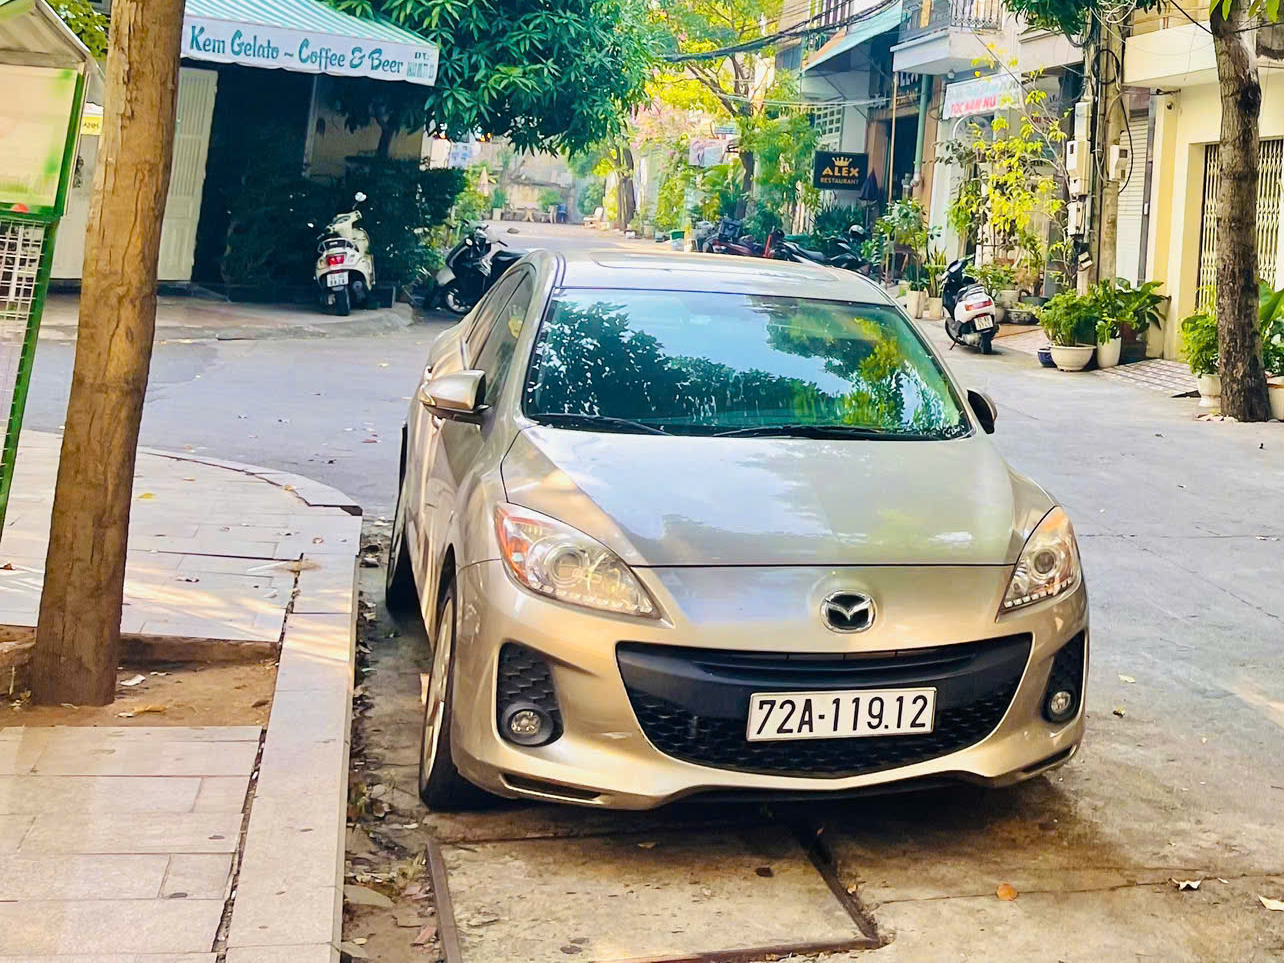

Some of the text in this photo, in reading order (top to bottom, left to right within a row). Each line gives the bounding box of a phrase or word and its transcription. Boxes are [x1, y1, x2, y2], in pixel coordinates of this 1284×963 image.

[190, 25, 226, 54] Kem
[230, 29, 280, 59] Gelato
[298, 37, 345, 71] Coffee
[350, 46, 366, 69] &
[368, 48, 404, 74] Beer
[821, 166, 860, 177] ALEX
[756, 694, 929, 735] 72A-119.12
